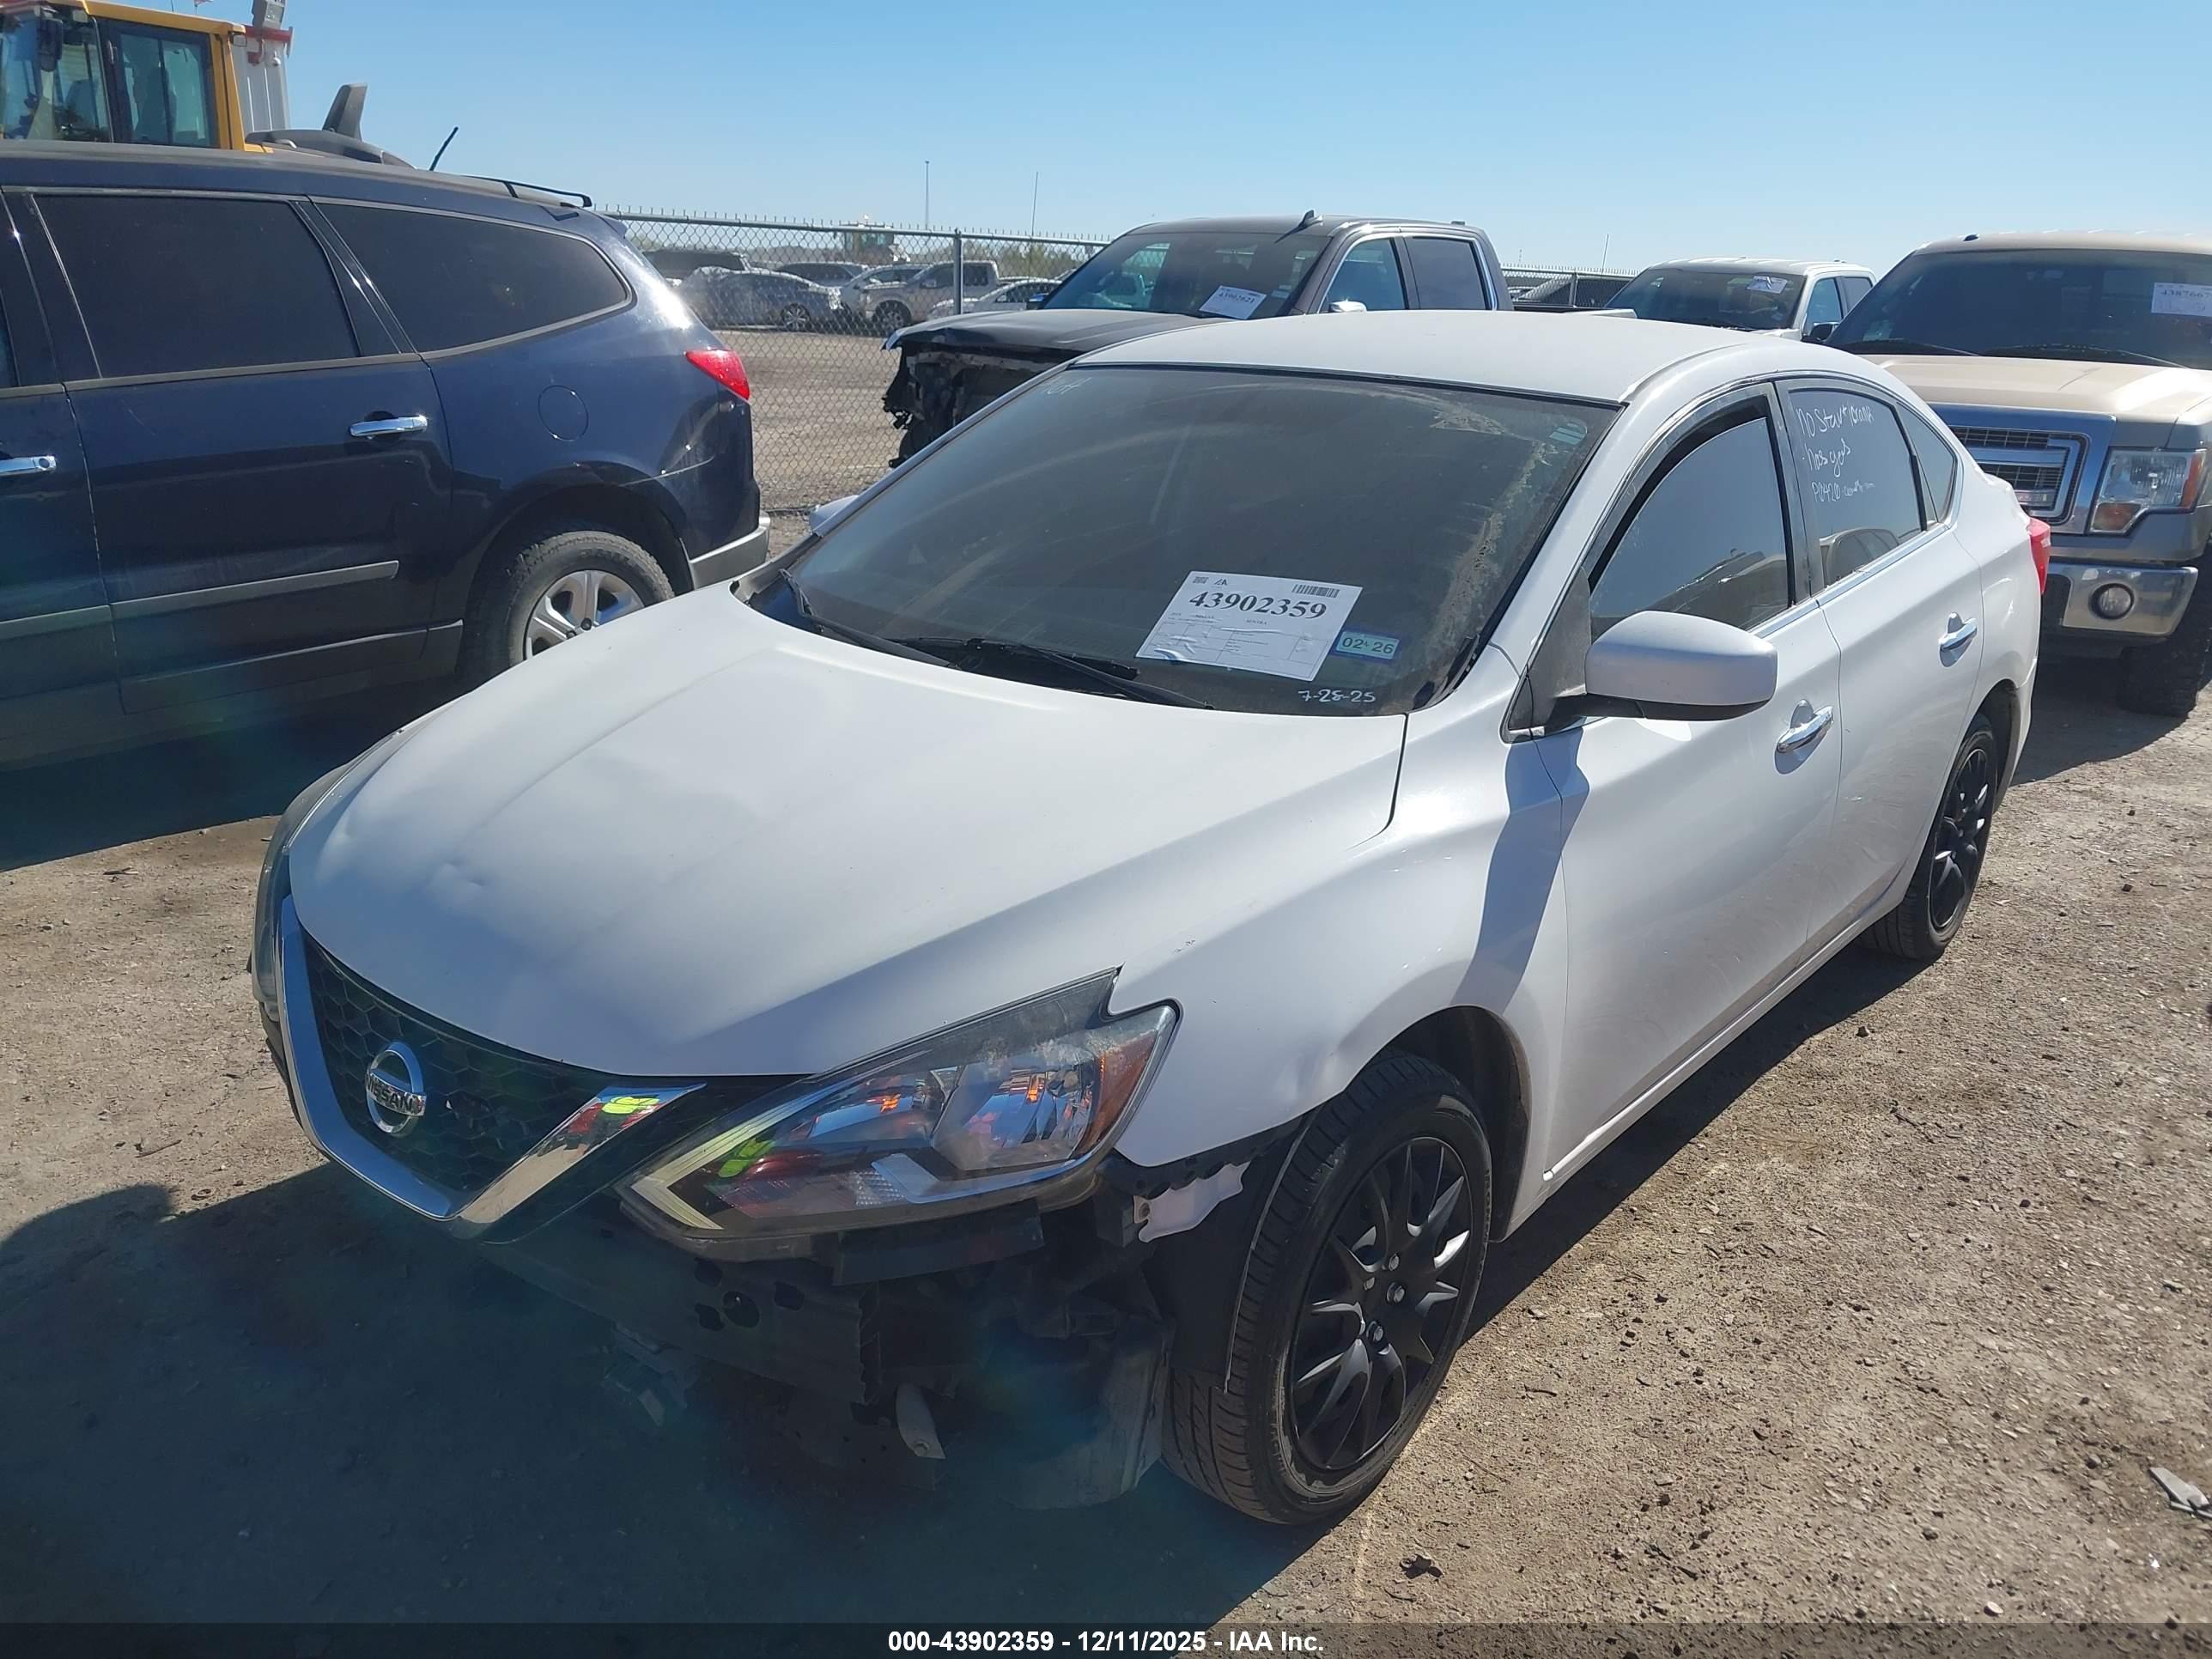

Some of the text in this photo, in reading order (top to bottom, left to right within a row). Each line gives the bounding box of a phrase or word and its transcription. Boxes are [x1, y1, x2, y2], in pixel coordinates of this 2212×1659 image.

[1188, 591, 1327, 619] 43902359
[1342, 637, 1395, 654] 02 26
[1297, 689, 1376, 702] 7-28-25
